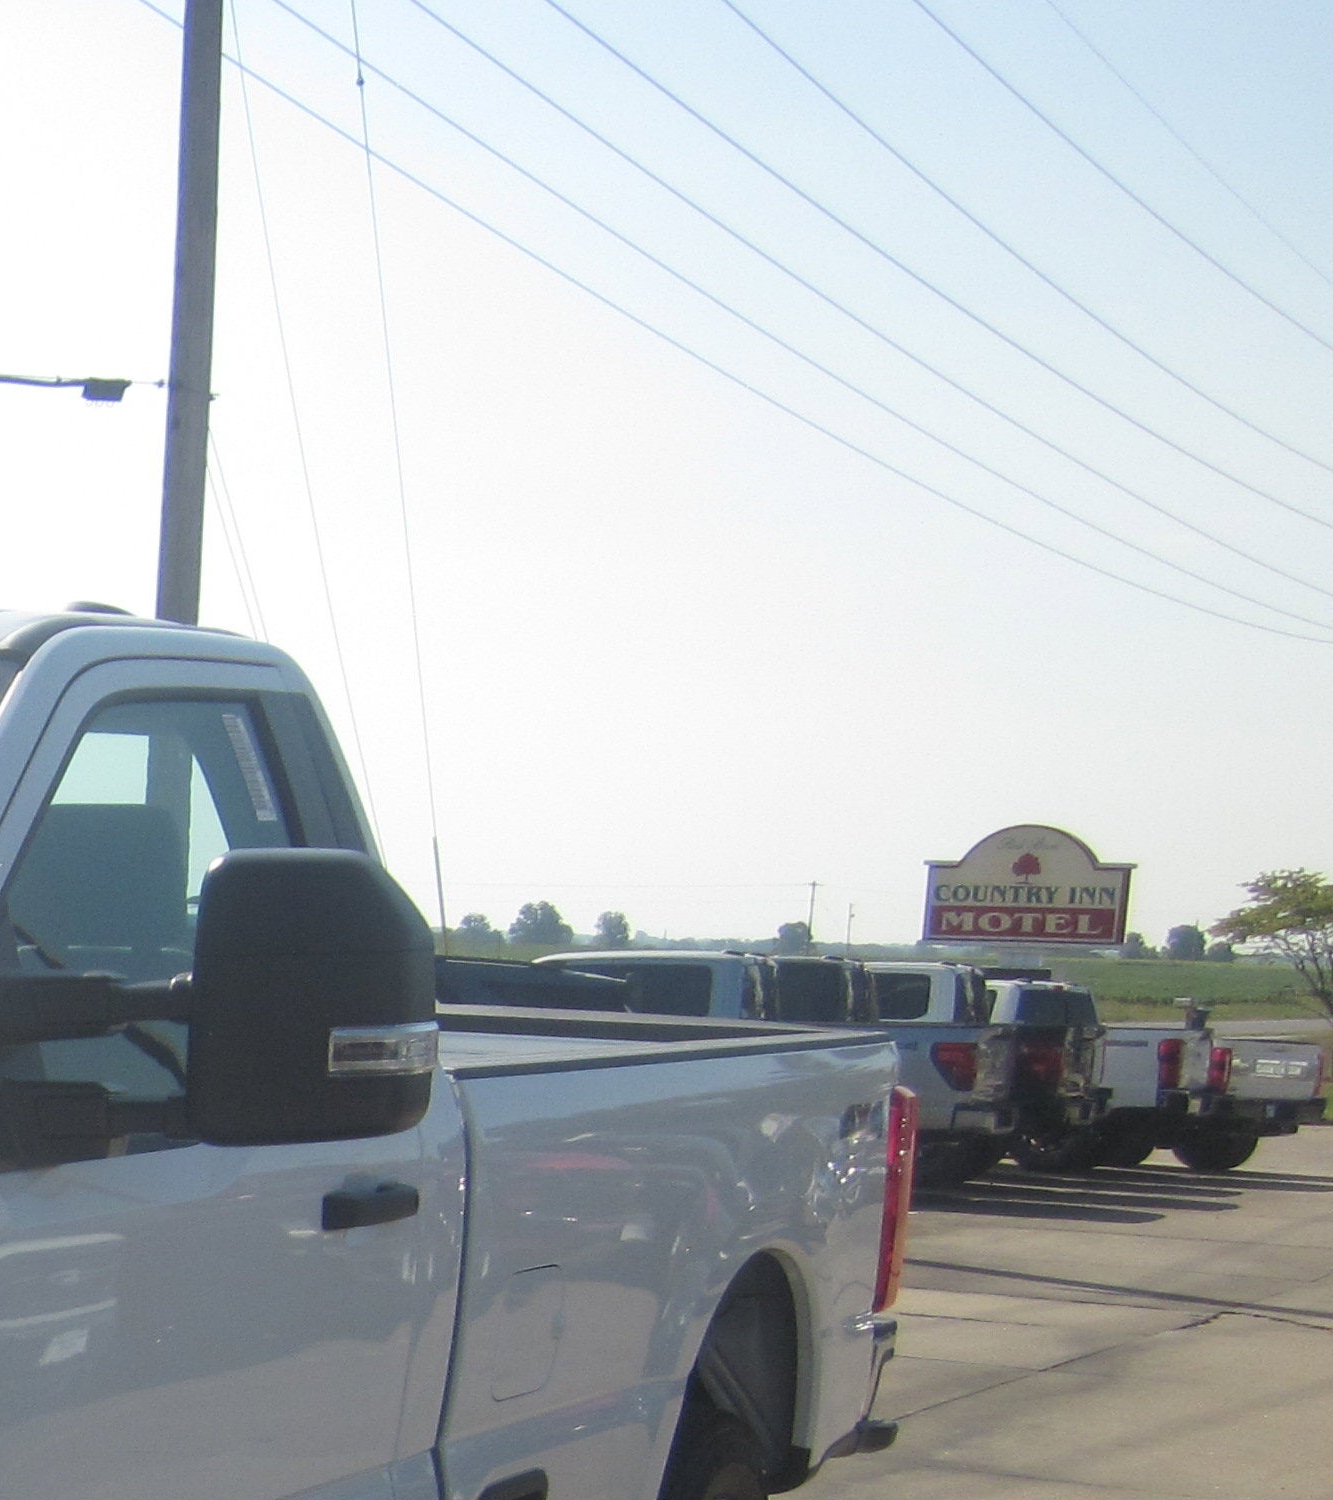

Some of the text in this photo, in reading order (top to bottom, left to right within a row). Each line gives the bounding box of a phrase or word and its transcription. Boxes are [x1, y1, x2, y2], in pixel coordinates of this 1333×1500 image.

[934, 884, 1116, 905] COUNTRY INN
[940, 911, 1103, 935] MOTEL
